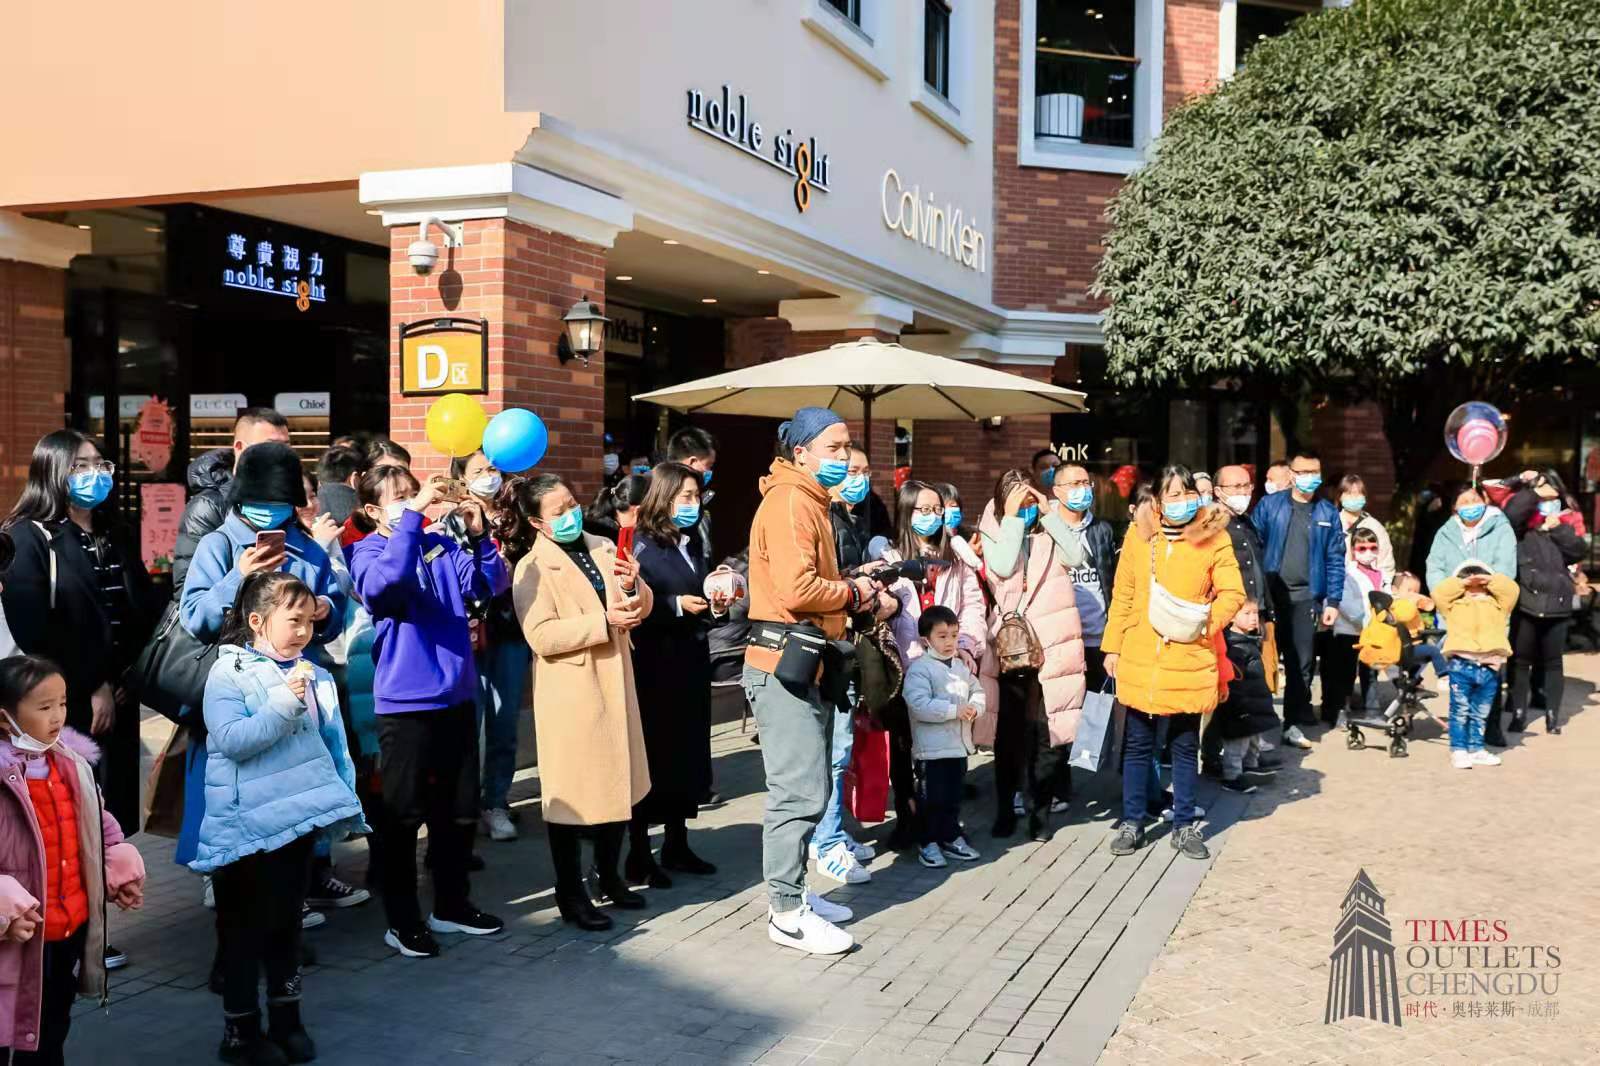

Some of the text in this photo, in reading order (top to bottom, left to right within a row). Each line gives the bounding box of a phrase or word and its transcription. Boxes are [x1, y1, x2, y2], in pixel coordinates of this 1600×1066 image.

[687, 84, 830, 213] noble sight
[224, 265, 326, 312] noble sight
[299, 399, 326, 409] Chloé
